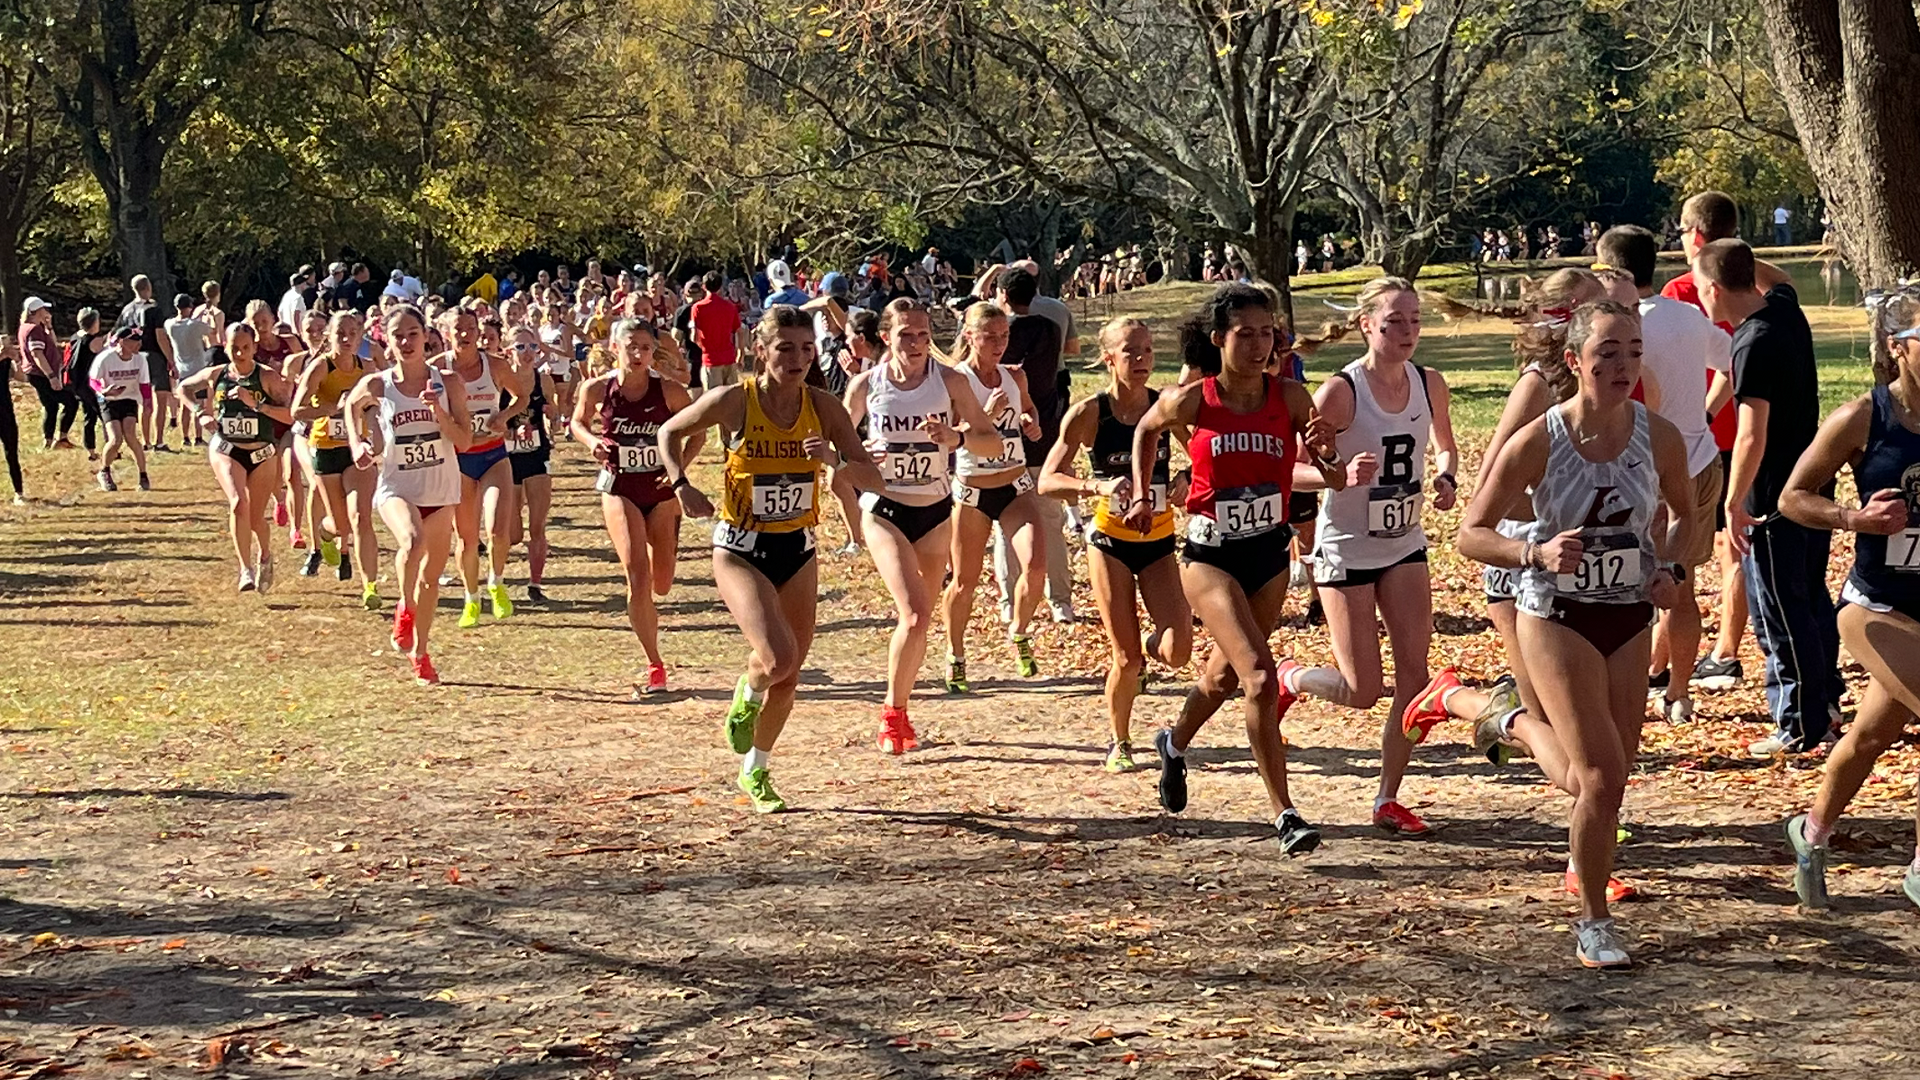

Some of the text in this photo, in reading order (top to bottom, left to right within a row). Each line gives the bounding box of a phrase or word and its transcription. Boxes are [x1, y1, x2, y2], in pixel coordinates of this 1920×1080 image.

[228, 420, 252, 434] 540
[390, 409, 440, 431] MEREDI
[612, 416, 660, 436] Trinity
[404, 443, 437, 464] 534
[628, 448, 657, 467] 810
[746, 440, 809, 459] SALISBU
[1210, 432, 1284, 458] RHODES
[894, 456, 932, 481] 542
[1378, 433, 1416, 486] B
[764, 487, 803, 514] 552
[1227, 500, 1274, 532] 544
[1383, 500, 1414, 530] 617
[1905, 533, 1920, 567] 7
[1574, 555, 1625, 591] 912
